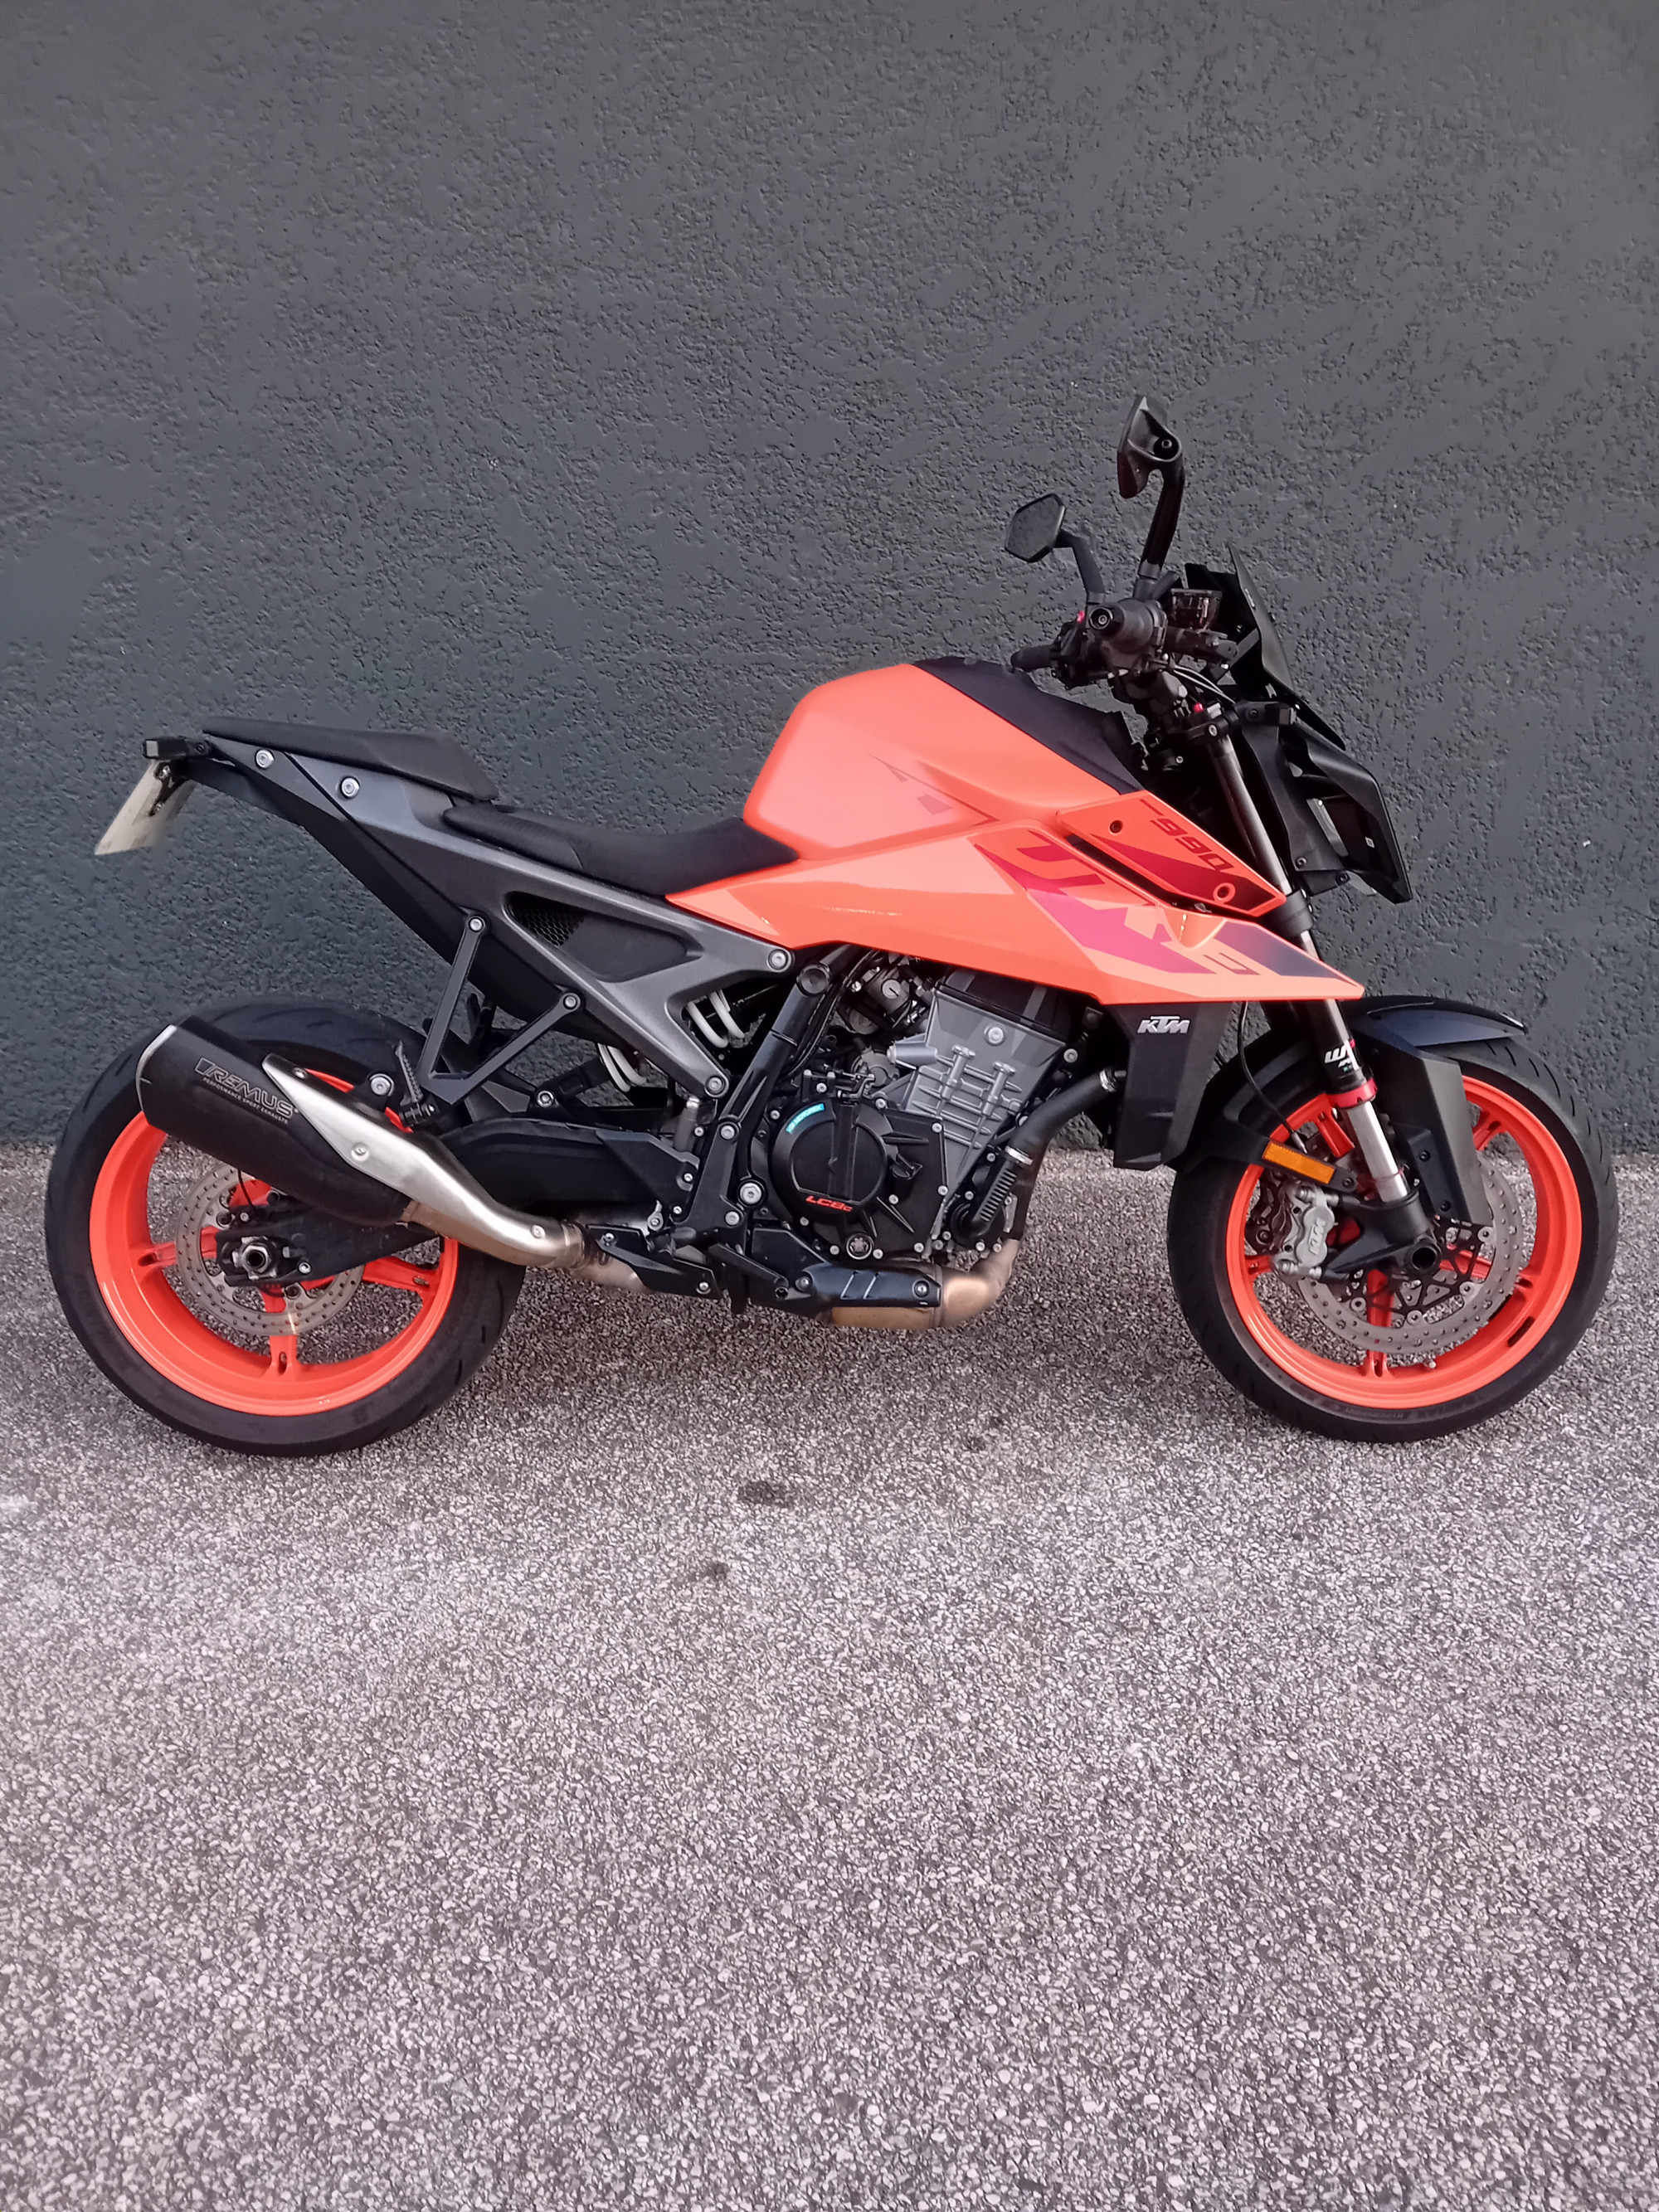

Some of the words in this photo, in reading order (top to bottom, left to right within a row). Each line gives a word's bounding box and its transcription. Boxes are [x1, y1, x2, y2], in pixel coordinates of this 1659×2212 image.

[1136, 1015, 1190, 1034] KTM
[204, 1063, 294, 1119] REMUS
[1308, 1217, 1326, 1256] KTM
